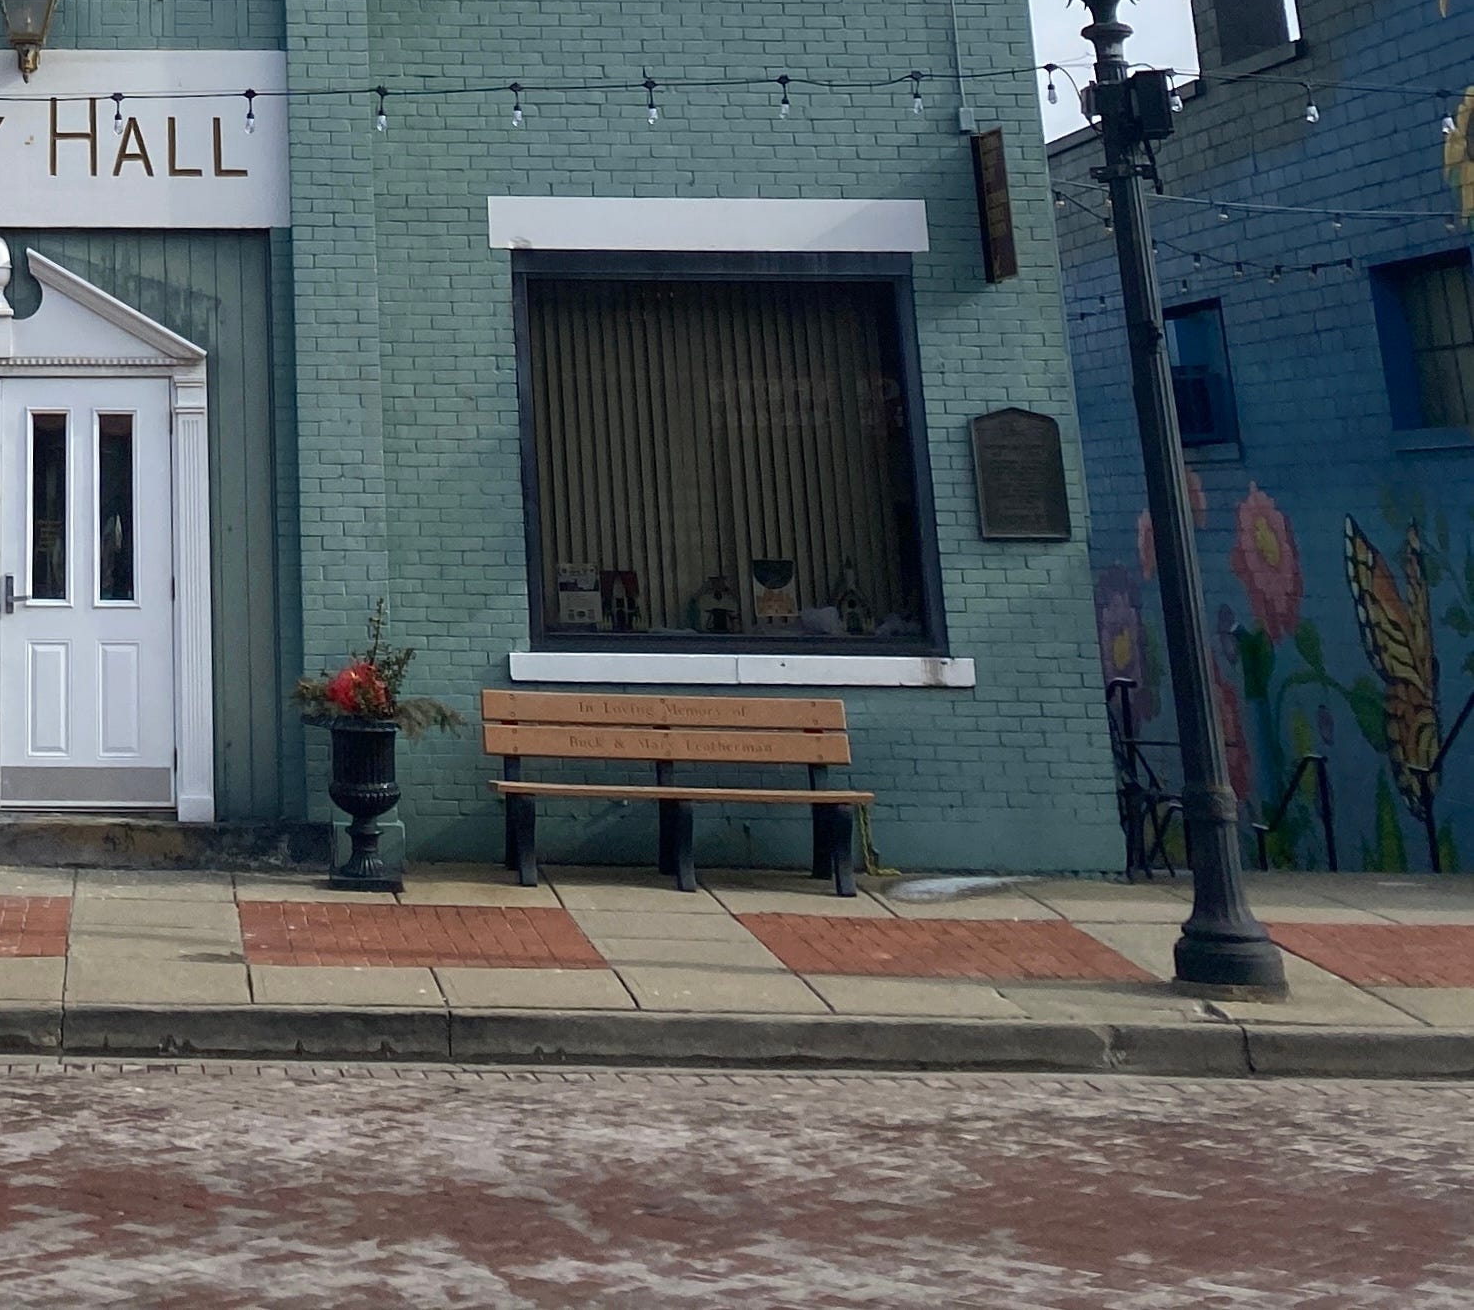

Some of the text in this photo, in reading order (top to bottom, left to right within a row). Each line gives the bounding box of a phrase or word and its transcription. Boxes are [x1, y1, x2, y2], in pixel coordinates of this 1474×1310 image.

[48, 96, 249, 178] HALL
[578, 701, 746, 718] In Loving Memory of
[569, 735, 602, 749] Buck
[613, 739, 625, 749] &
[685, 739, 773, 753] Leatherman
